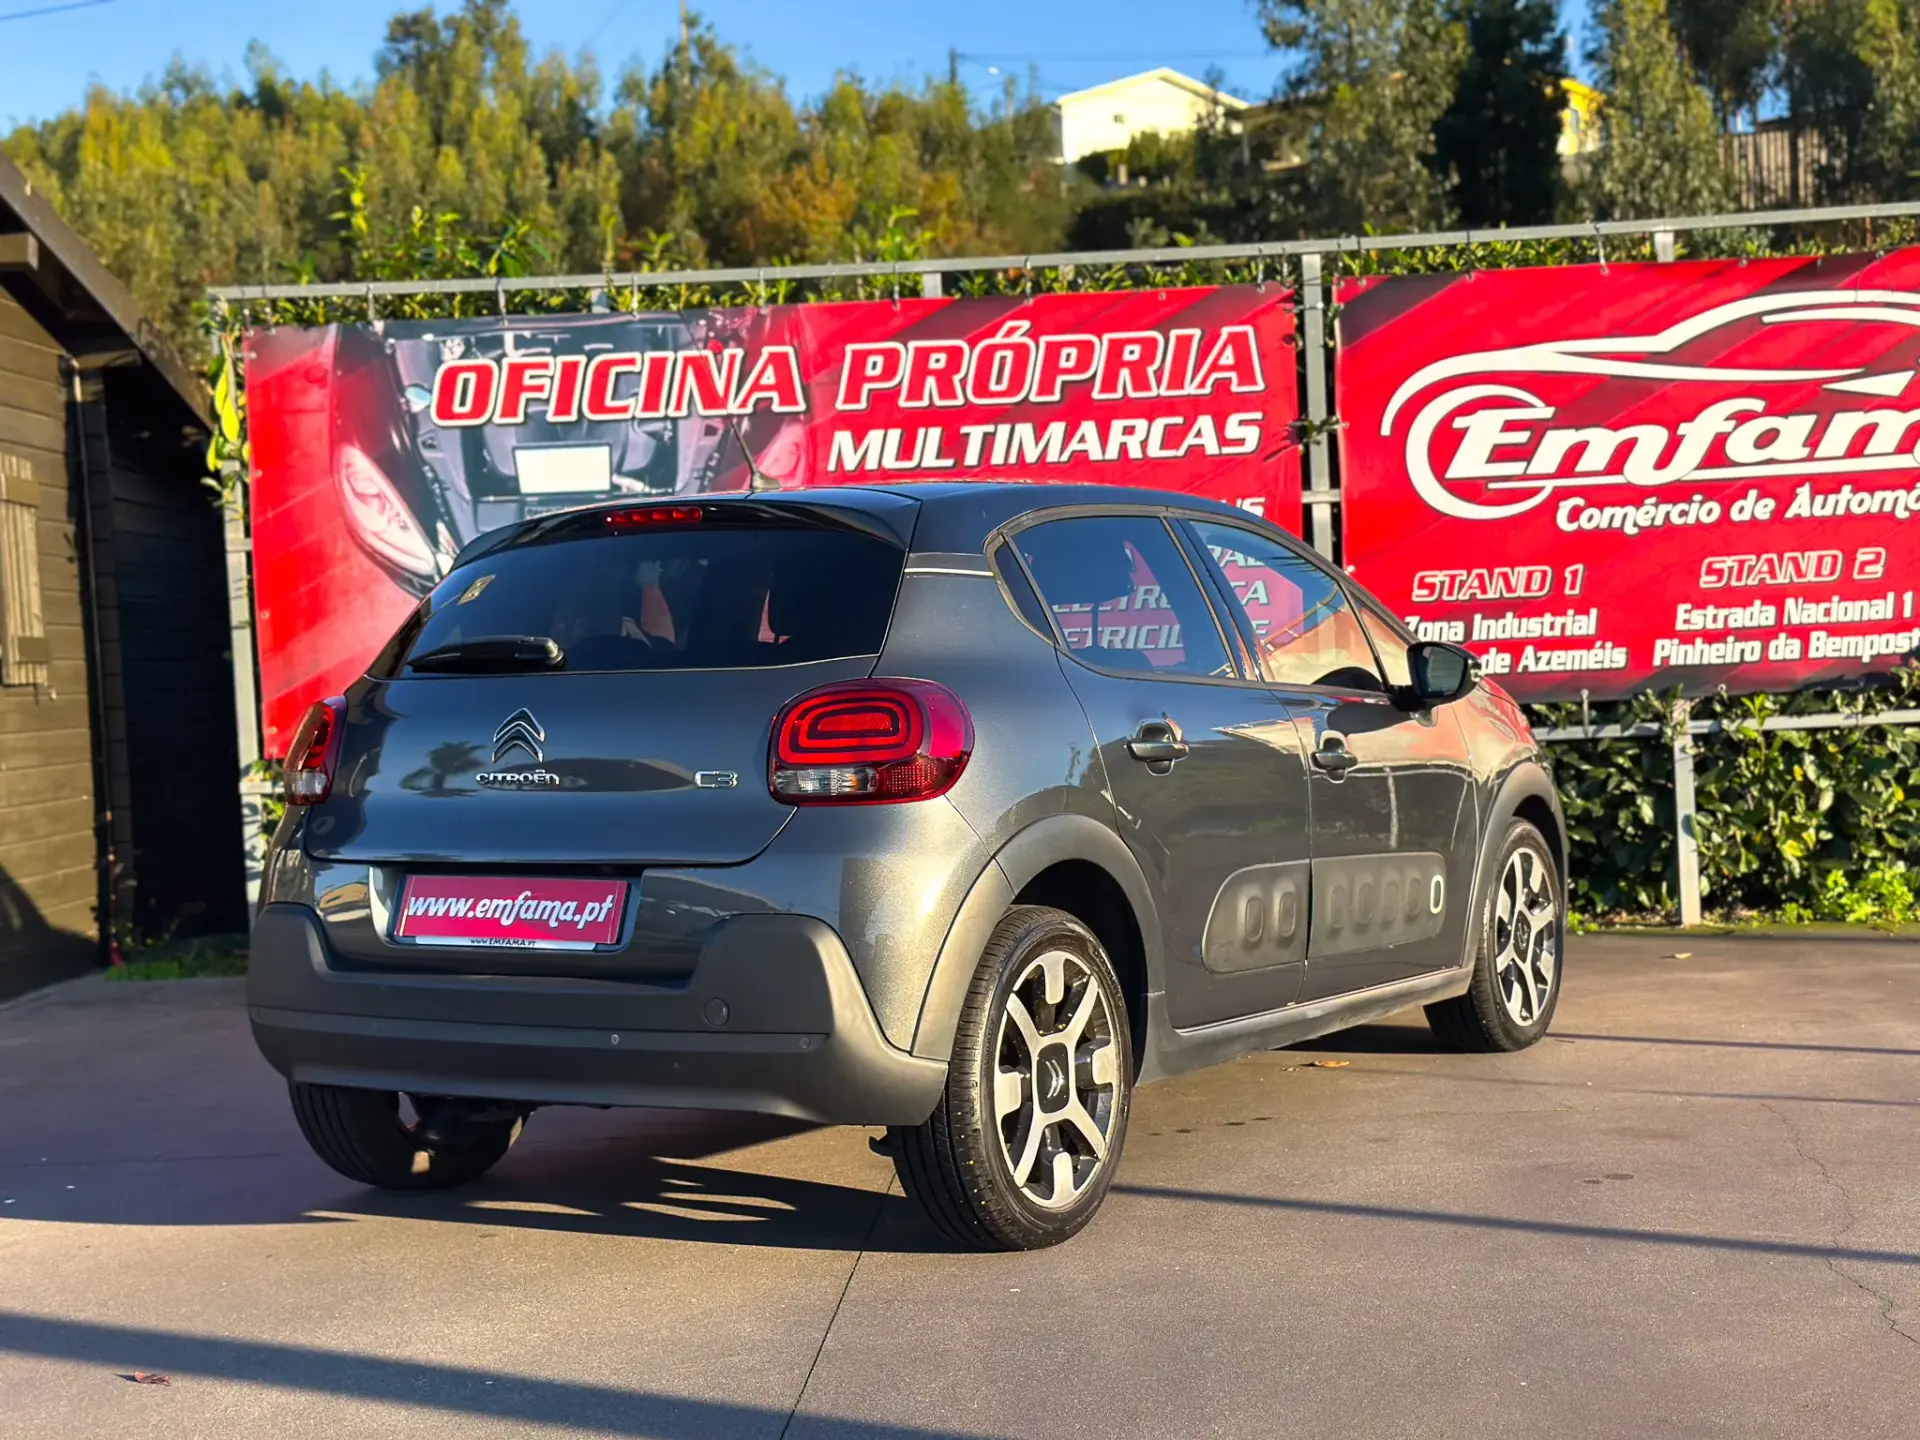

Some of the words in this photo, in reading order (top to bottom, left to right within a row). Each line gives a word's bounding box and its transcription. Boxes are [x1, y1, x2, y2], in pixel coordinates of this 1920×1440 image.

[430, 346, 806, 427] OFICINA
[836, 320, 1264, 411] PRÓPRIA
[827, 412, 1262, 472] MULTIMARCAS
[1556, 494, 1721, 535] Comércio
[1730, 489, 1776, 522] de
[1412, 566, 1552, 602] STAND
[1564, 564, 1584, 596] 1
[1699, 550, 1843, 588] STAND
[1853, 547, 1886, 580] 2
[1472, 608, 1597, 641] Industrial
[1675, 600, 1776, 631] Estrada
[1783, 592, 1895, 626] Nacional
[1902, 591, 1914, 618] 1
[1481, 647, 1510, 675] de
[1517, 641, 1628, 673] Azeméis
[1653, 635, 1761, 667] Pinheiro
[1768, 633, 1801, 661] da
[476, 769, 560, 786] CITROËN
[694, 771, 739, 788] C3
[408, 890, 614, 929] www.emfama.pt
